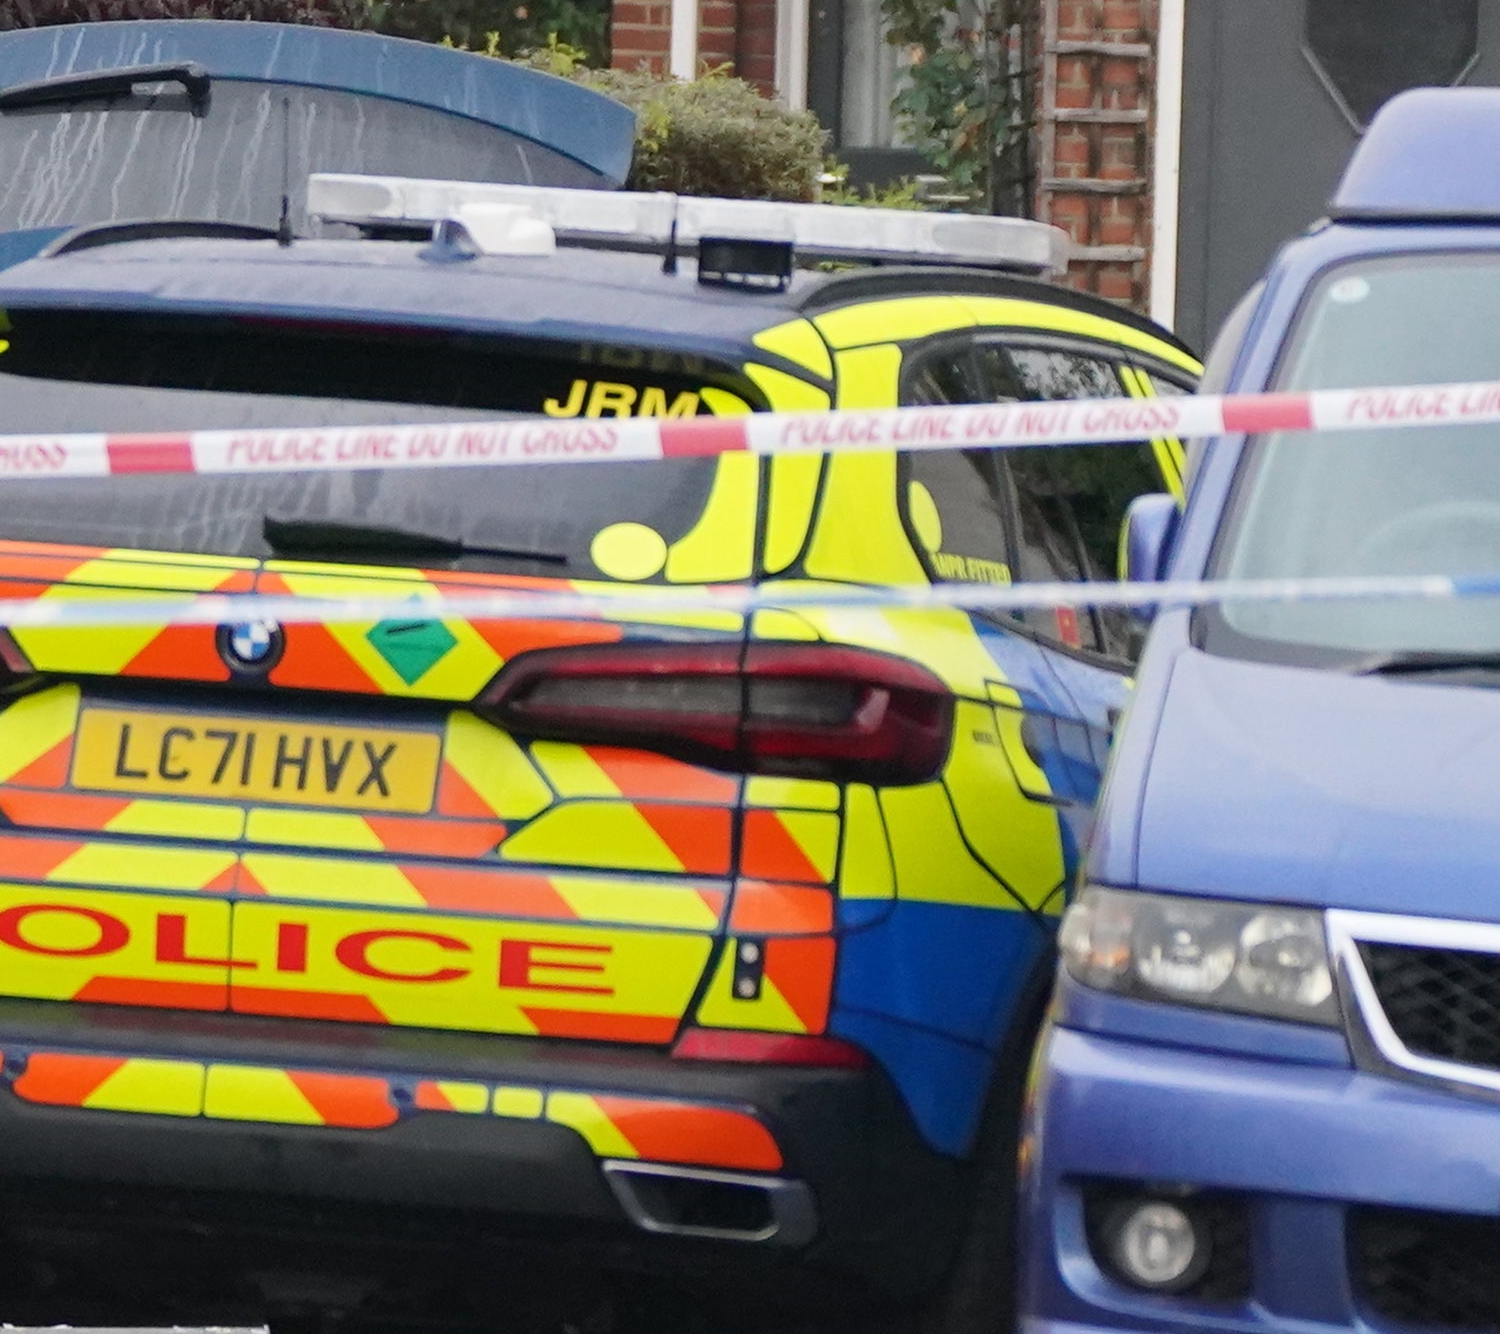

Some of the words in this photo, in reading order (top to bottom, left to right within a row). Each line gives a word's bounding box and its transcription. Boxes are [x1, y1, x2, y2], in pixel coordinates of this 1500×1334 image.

[543, 379, 702, 419] JRM
[226, 429, 326, 464] POLICE
[335, 427, 398, 462] LINE
[407, 425, 447, 459] DO
[456, 424, 513, 457] NOT
[523, 422, 620, 454] CROSS
[780, 417, 881, 446] POLICE
[889, 415, 957, 442] LINE
[964, 412, 1009, 440] DO
[1014, 409, 1070, 437] NOT
[1081, 405, 1181, 434] CROSS
[115, 723, 256, 788] LC71
[272, 734, 397, 798] HVX
